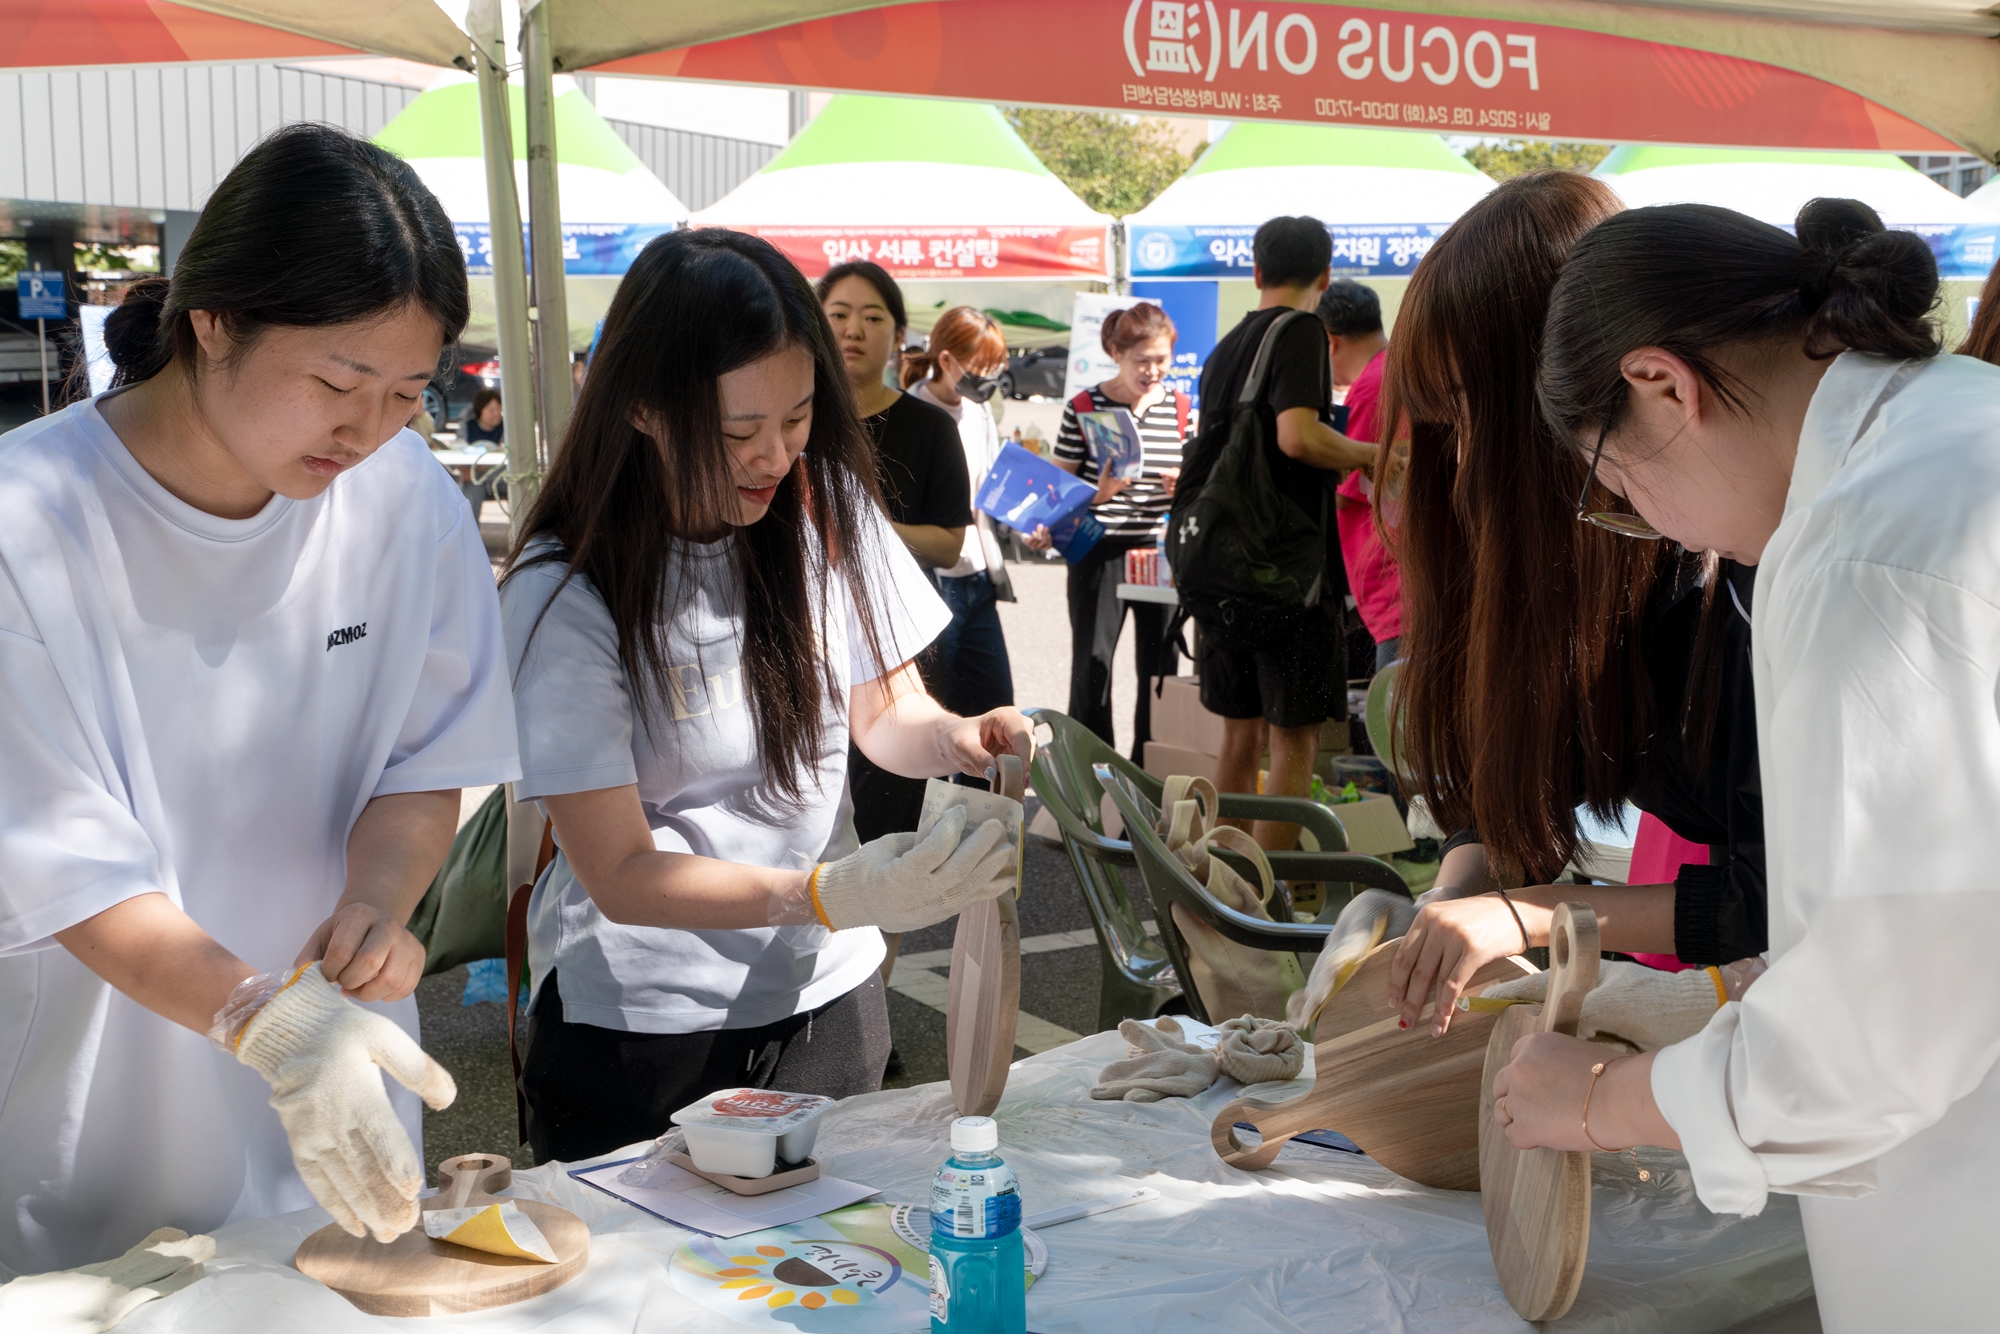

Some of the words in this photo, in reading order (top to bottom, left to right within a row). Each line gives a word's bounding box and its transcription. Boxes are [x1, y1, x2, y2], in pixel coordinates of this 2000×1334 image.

[875, 238, 926, 266] 서류
[928, 238, 999, 268] 컨설팅
[30, 278, 43, 299] P
